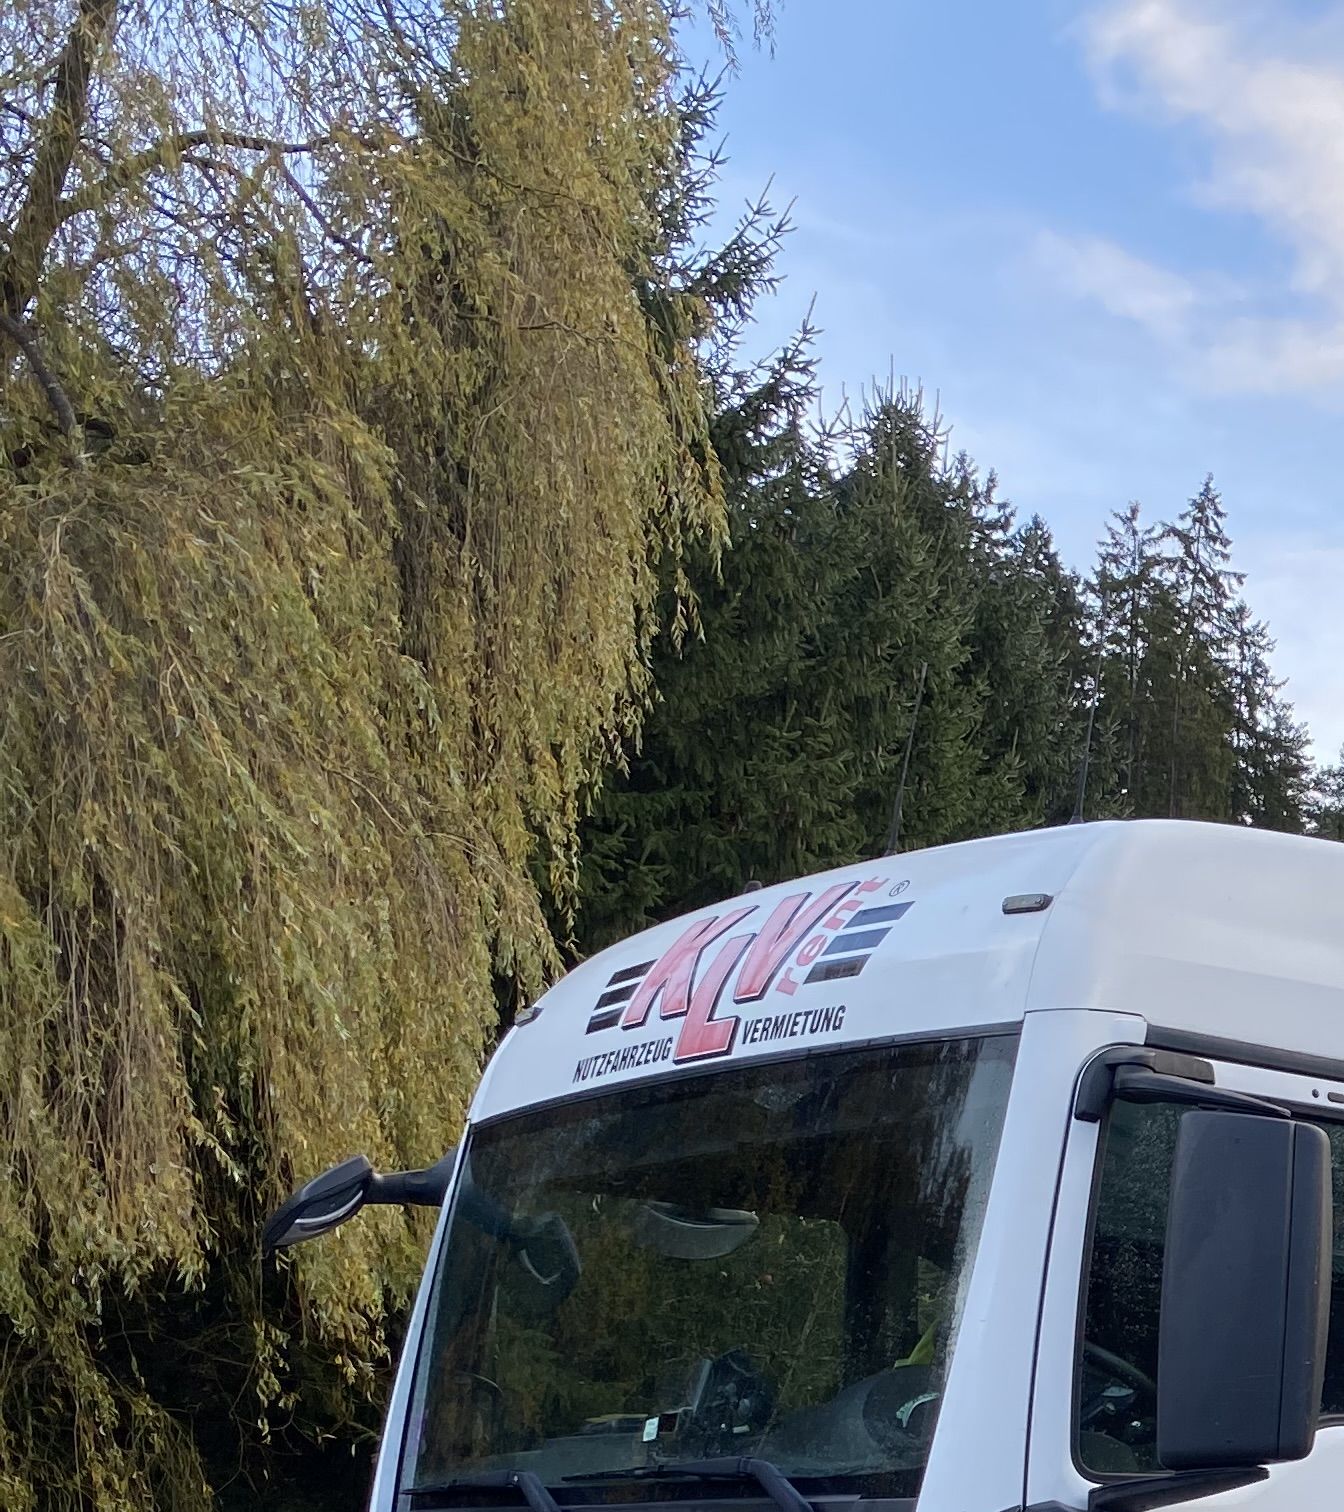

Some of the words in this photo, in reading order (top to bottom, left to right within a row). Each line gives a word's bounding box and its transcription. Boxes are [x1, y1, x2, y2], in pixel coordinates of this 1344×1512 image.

[621, 880, 860, 1065] KLV
[775, 876, 889, 996] rent
[572, 1037, 674, 1083] NUTZFAHRZEUG
[741, 1005, 847, 1044] VERMIETUNG
